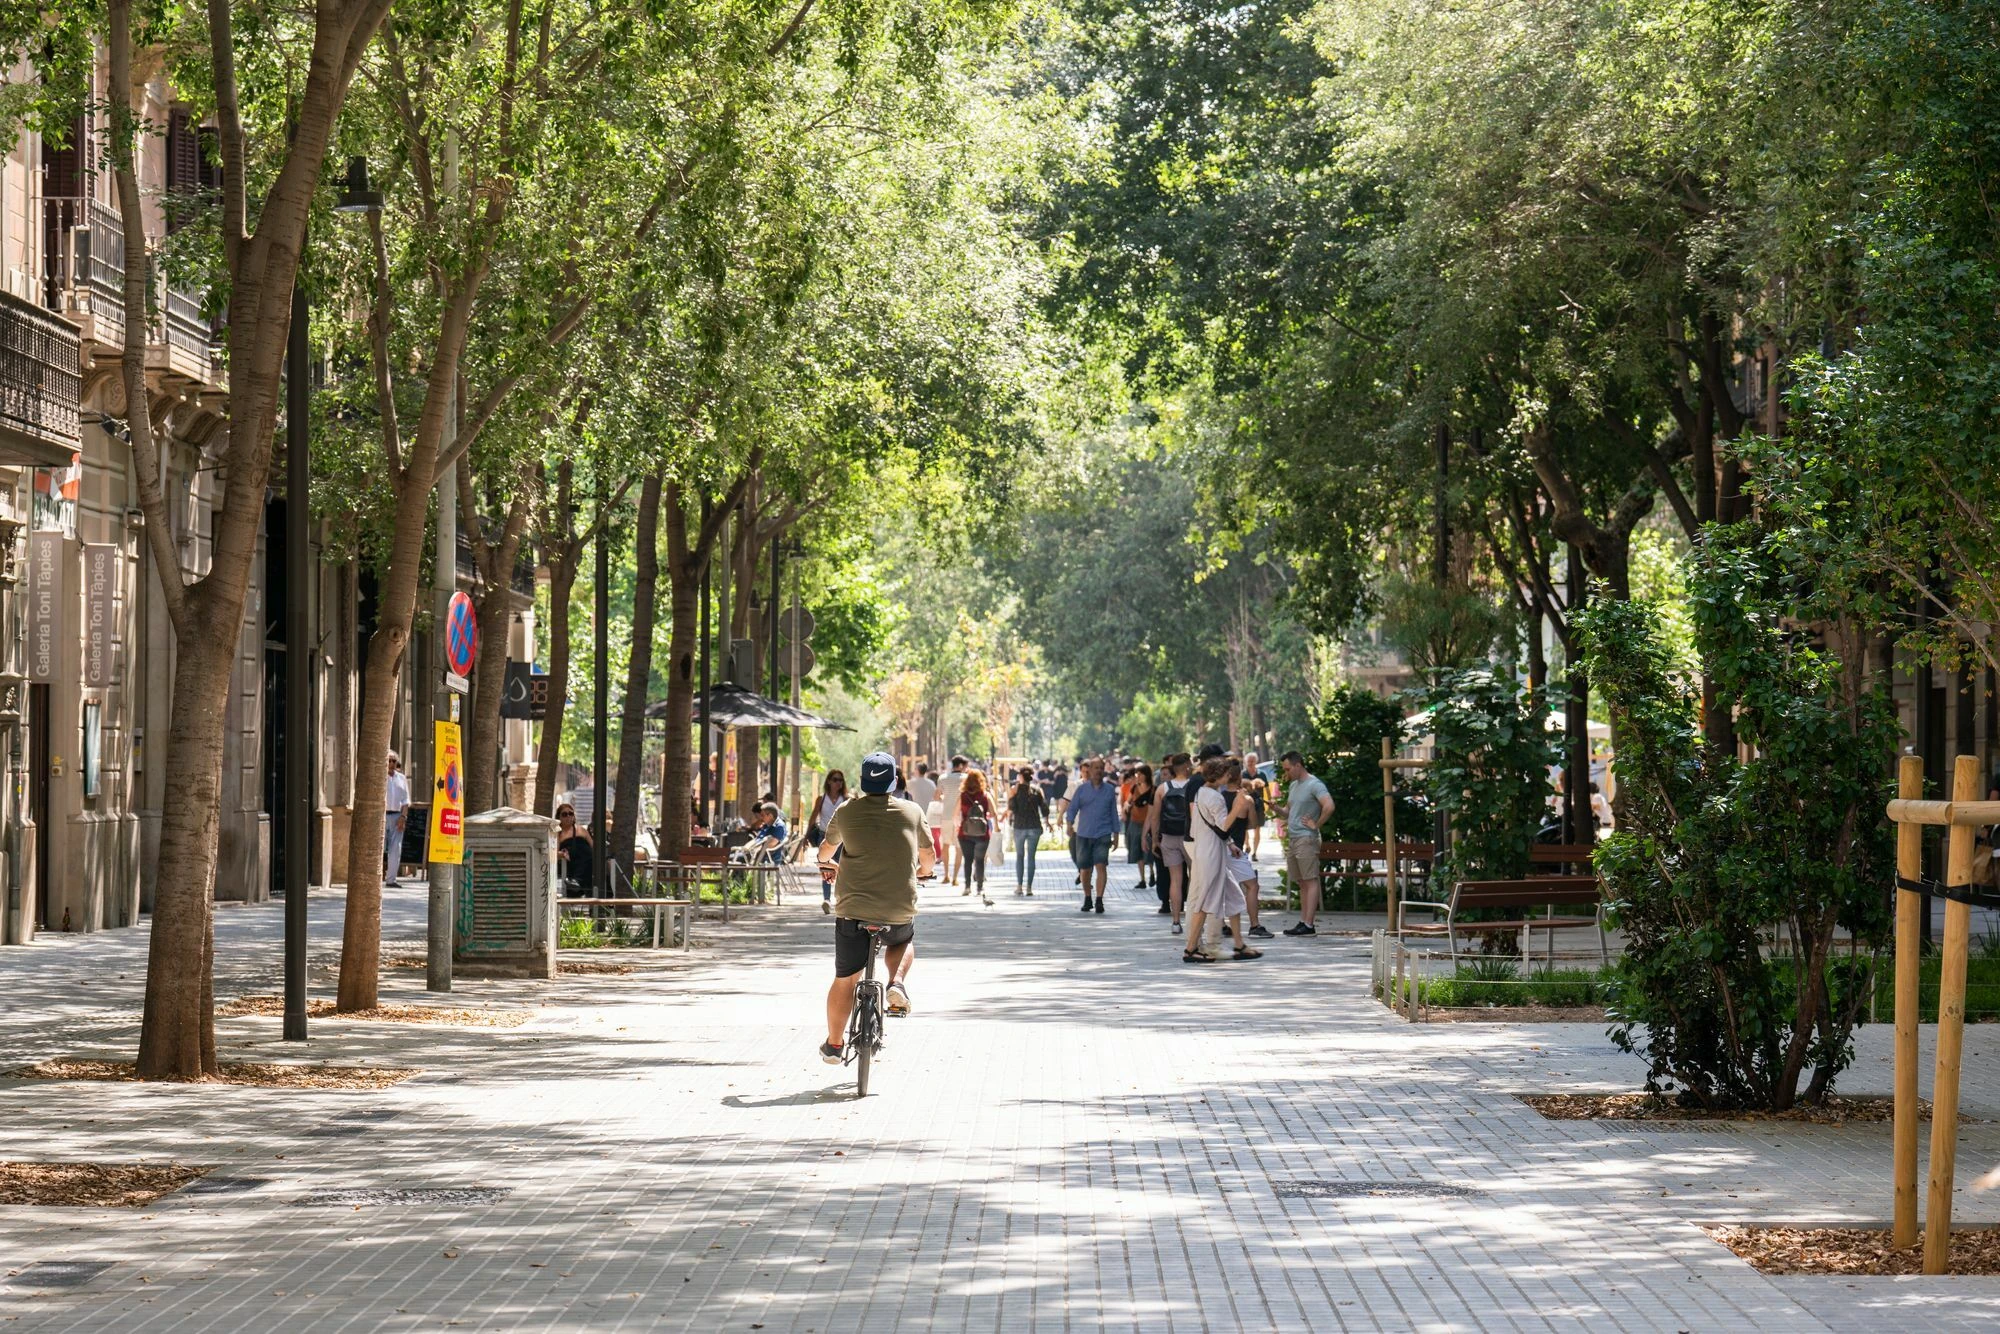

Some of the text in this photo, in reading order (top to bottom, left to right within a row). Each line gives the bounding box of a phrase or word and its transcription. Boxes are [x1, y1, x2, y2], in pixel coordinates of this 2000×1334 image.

[36, 540, 54, 676] Galeria Toni Tàpies
[90, 553, 106, 682] Galeria Toni Tàpies
